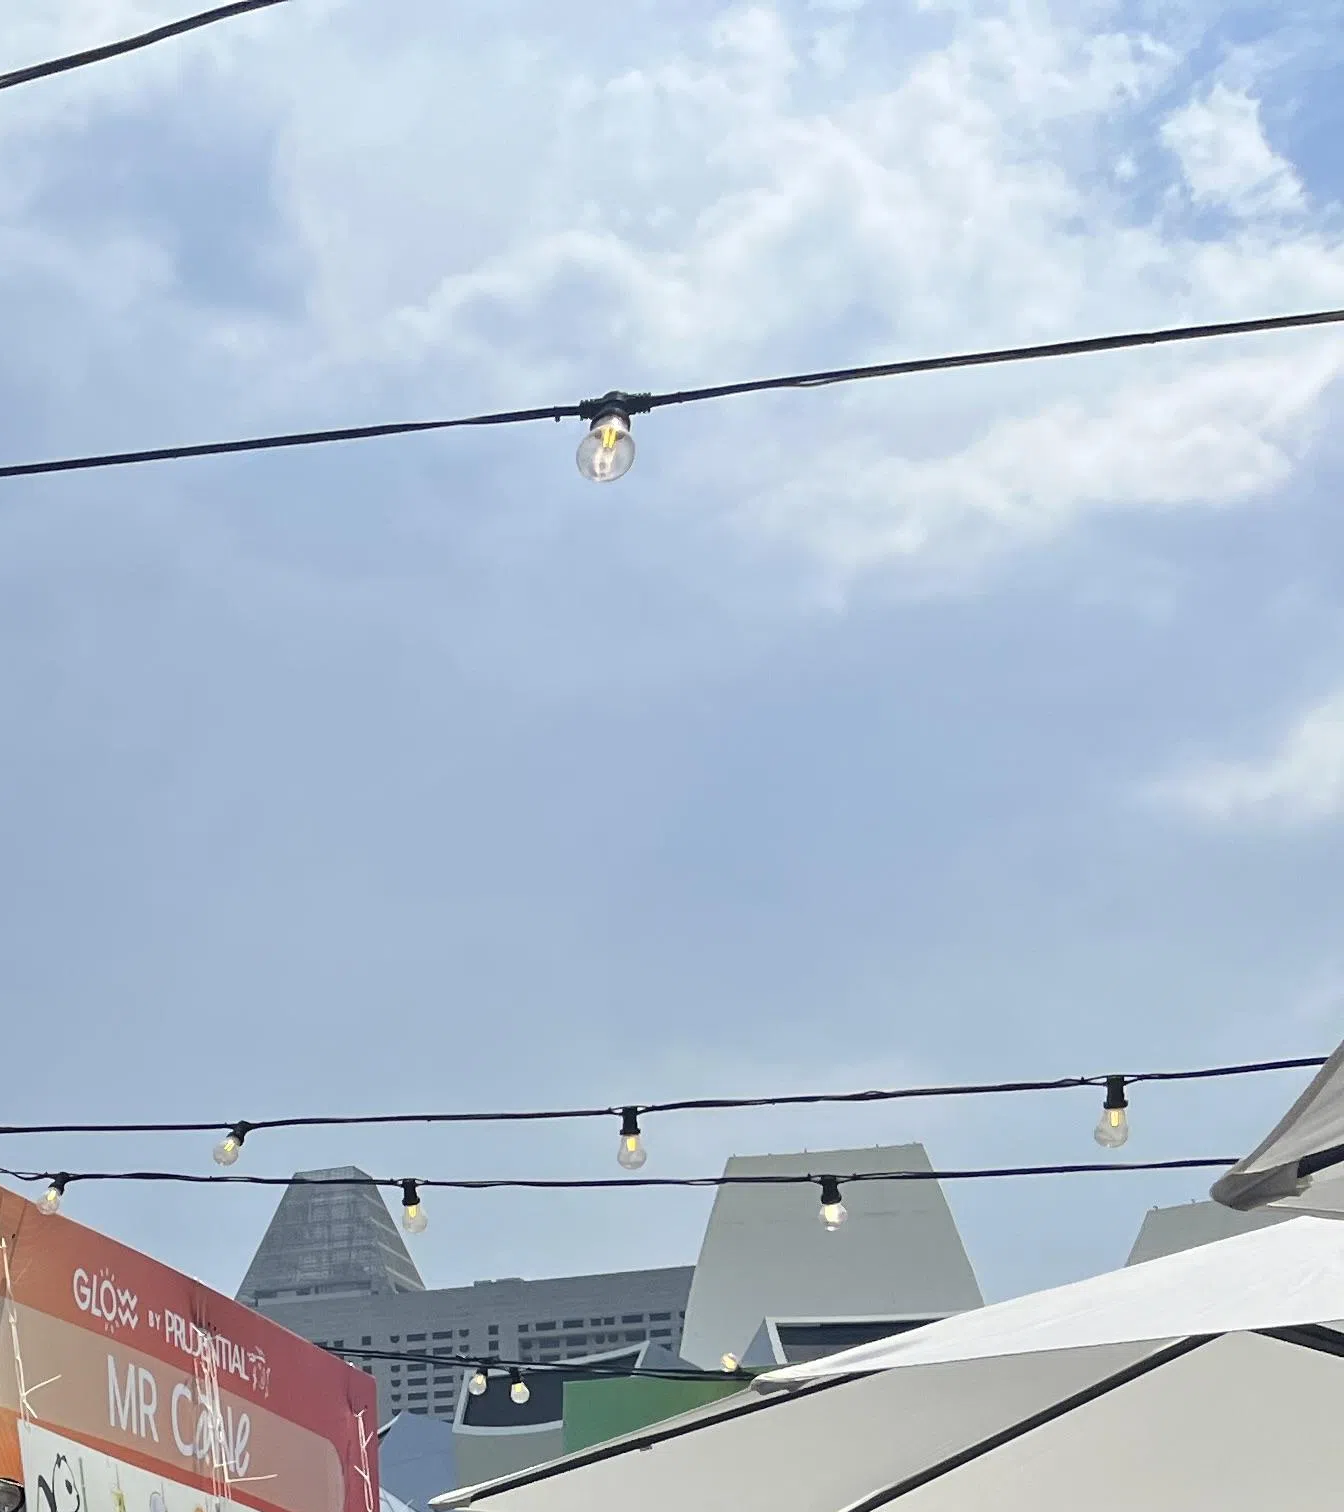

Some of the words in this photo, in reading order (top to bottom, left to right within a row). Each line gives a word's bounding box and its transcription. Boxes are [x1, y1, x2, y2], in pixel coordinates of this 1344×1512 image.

[73, 1268, 139, 1329] GLOW
[148, 1310, 161, 1331] BY
[107, 1354, 160, 1443] MR
